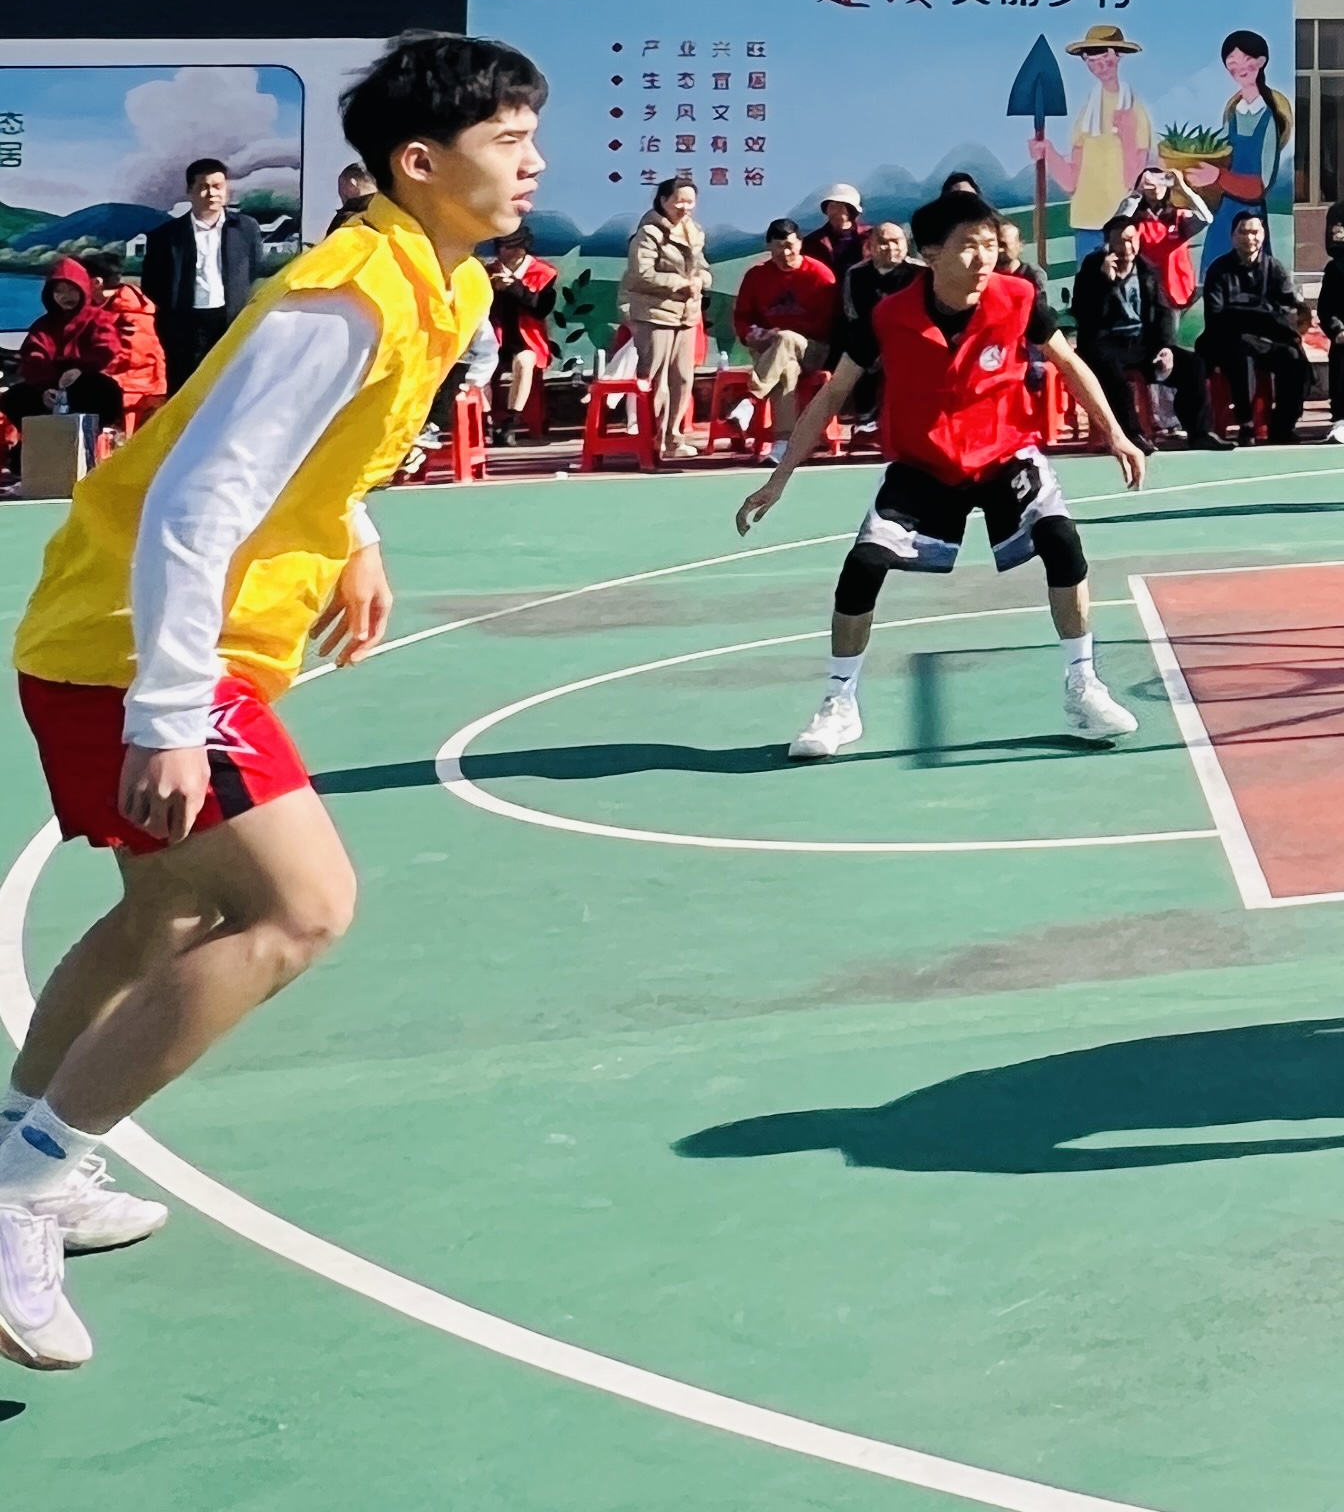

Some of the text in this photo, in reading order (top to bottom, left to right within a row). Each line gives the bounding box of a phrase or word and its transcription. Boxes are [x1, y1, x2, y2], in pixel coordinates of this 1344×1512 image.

[641, 40, 767, 58] 产业兴旺
[641, 72, 767, 90] 生态宜居
[642, 104, 767, 121] 乡风文明
[639, 135, 767, 153] 治理有效
